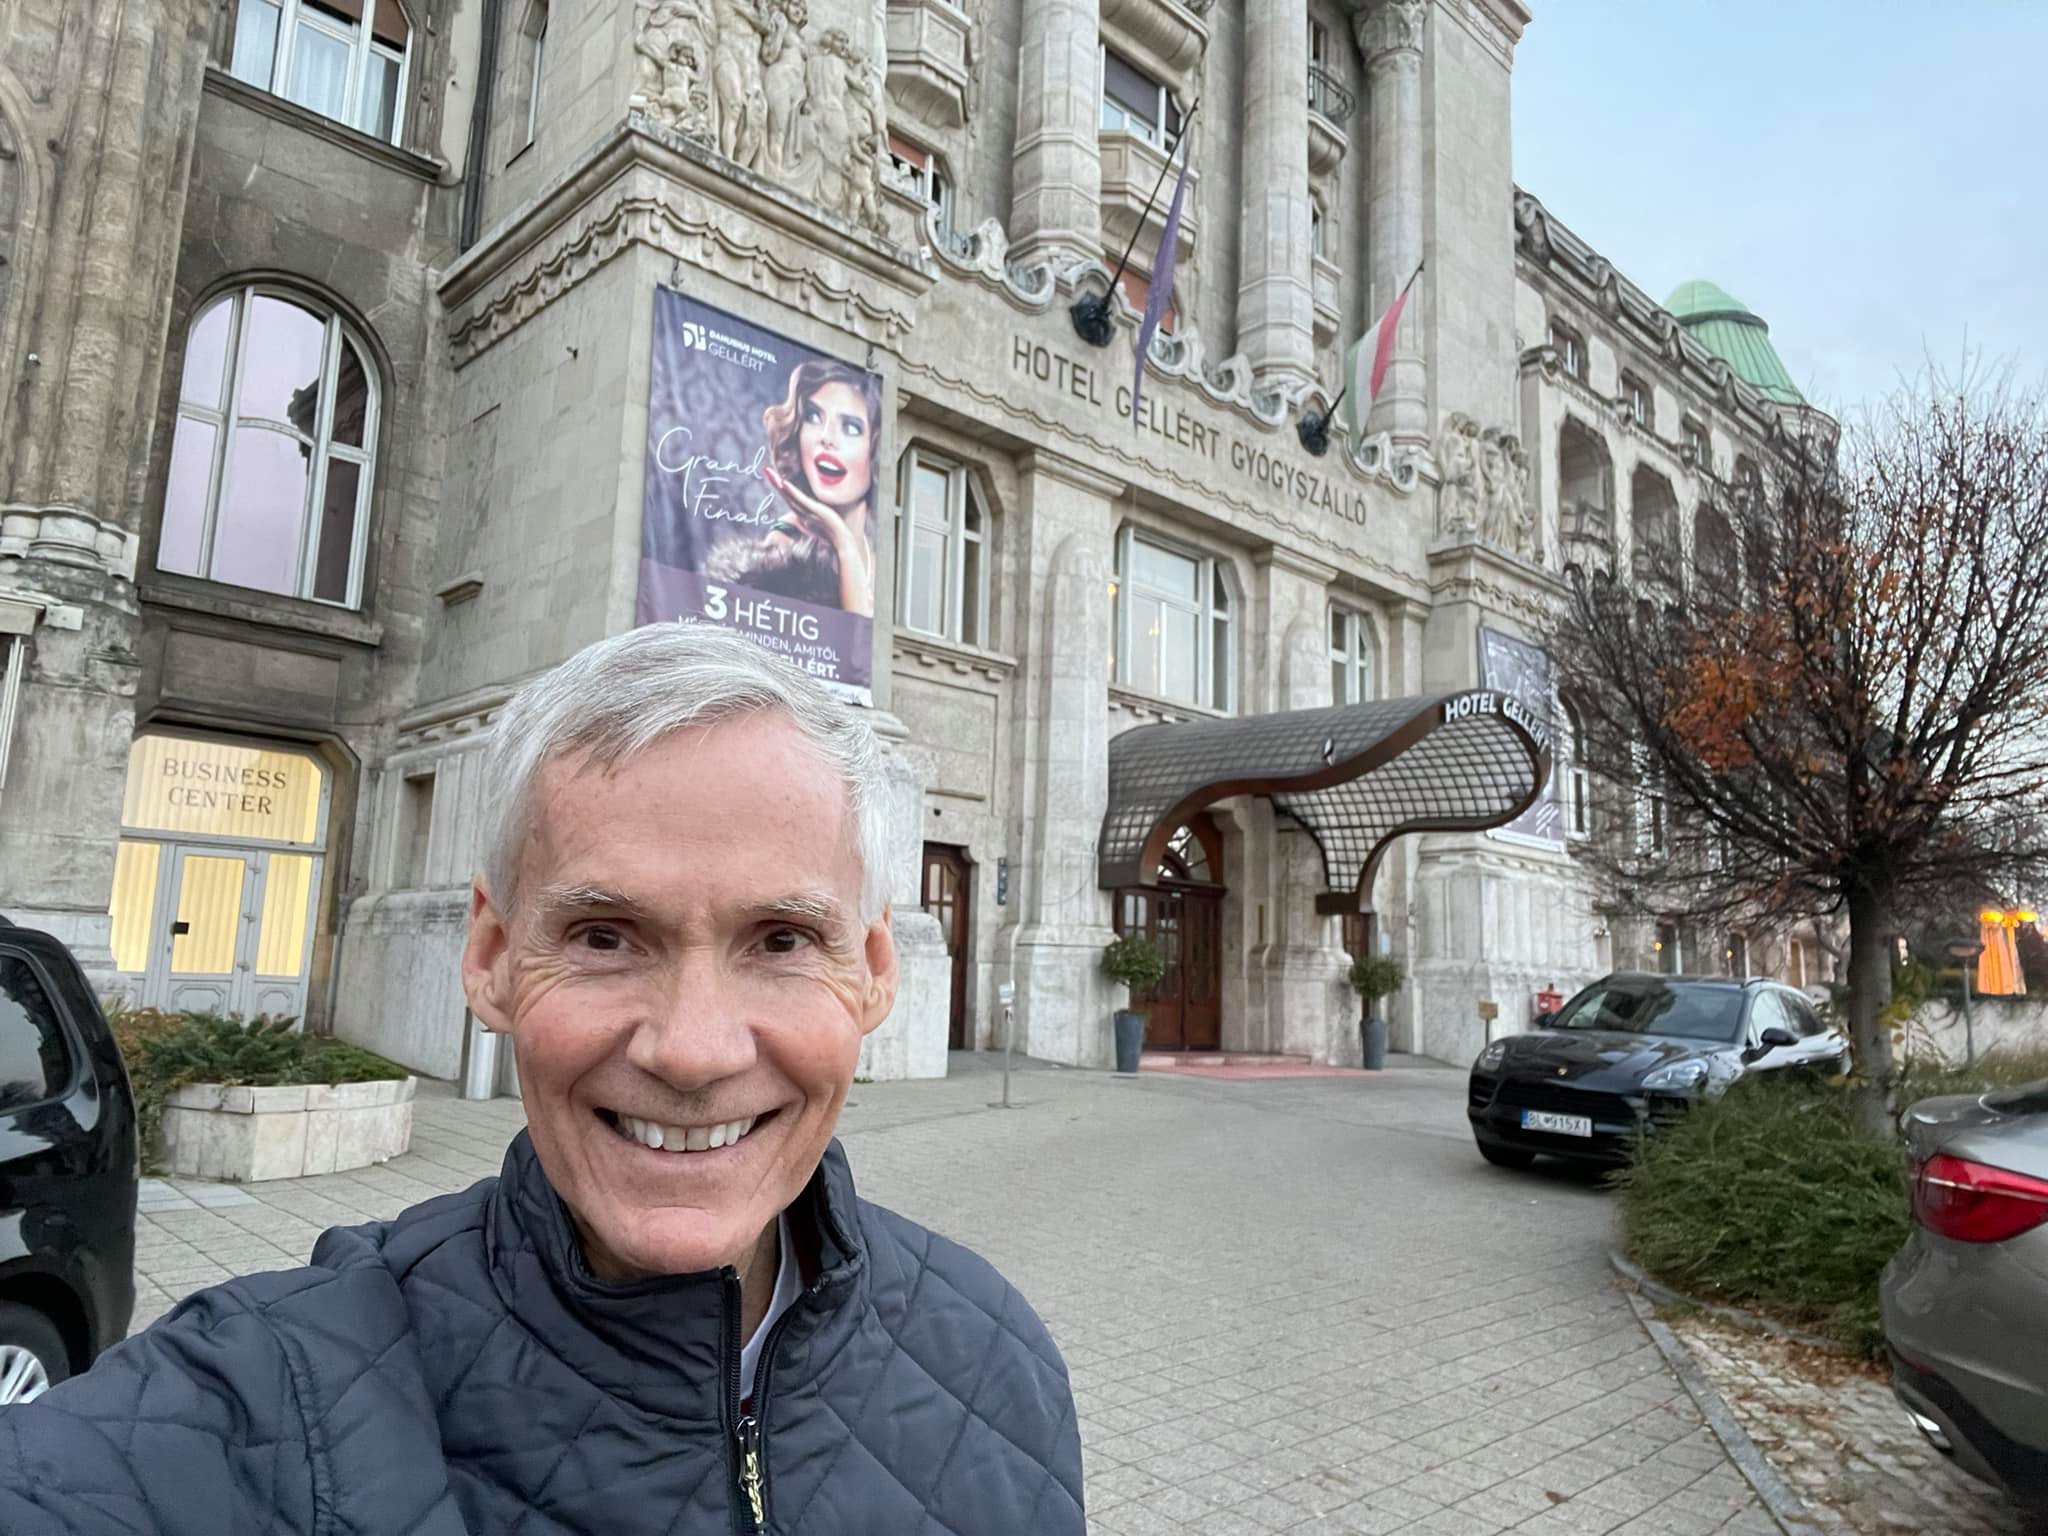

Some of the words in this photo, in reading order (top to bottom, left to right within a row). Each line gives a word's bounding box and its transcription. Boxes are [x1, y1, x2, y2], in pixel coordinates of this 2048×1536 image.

[708, 341, 765, 373] GELLÉRT
[751, 346, 778, 364] HOTEL
[1013, 335, 1102, 407] HOTEL
[1115, 385, 1220, 459] GELLÉRT
[1231, 440, 1366, 525] GYÓGYSZÁLLÓ
[656, 426, 766, 508] Grand
[694, 476, 776, 526] Finale
[704, 584, 728, 620] 3
[734, 597, 819, 641] HÉTIG
[1444, 692, 1498, 724] HOTEL
[163, 757, 288, 790] BUSINESS
[168, 785, 272, 815] CENTER
